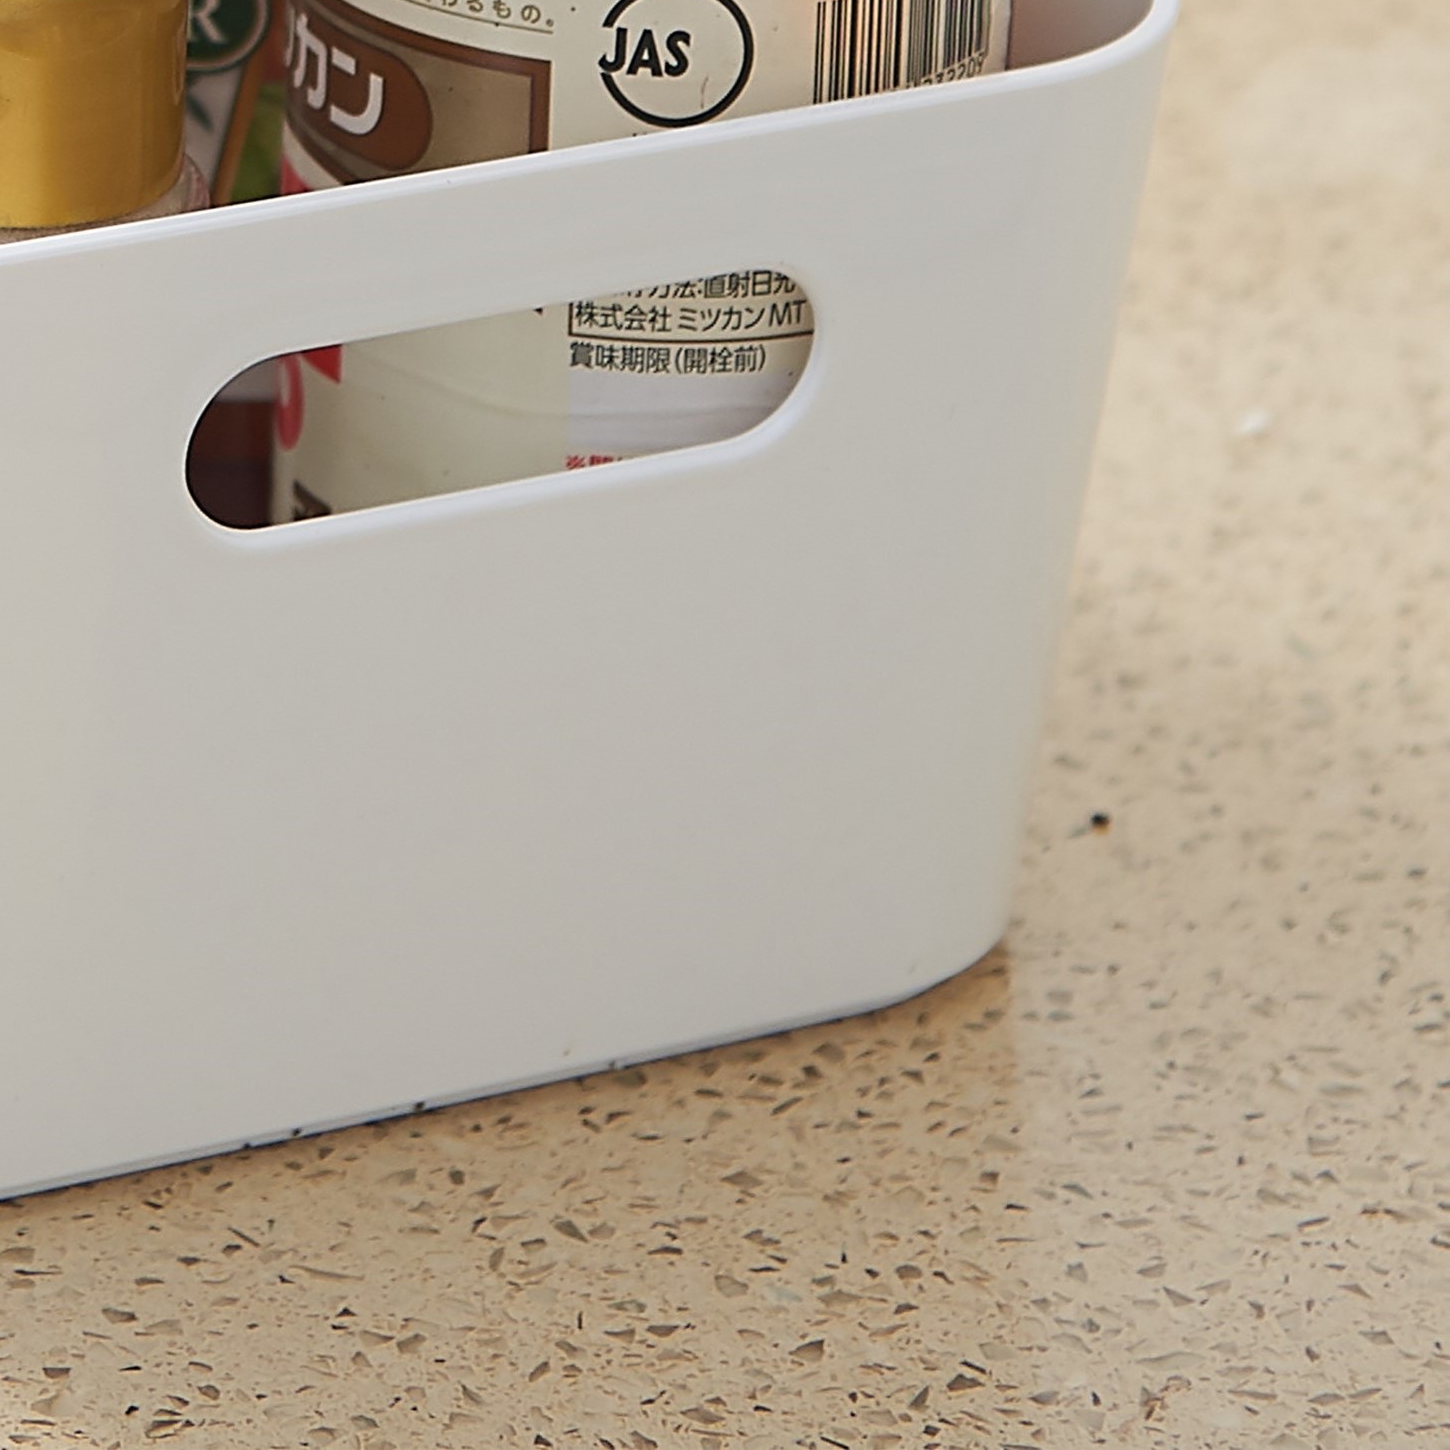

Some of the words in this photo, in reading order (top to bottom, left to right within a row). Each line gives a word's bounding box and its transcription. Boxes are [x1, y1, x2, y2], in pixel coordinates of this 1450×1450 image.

[598, 27, 691, 77] JAS
[570, 341, 766, 374] 賞味期限(開栓前)
